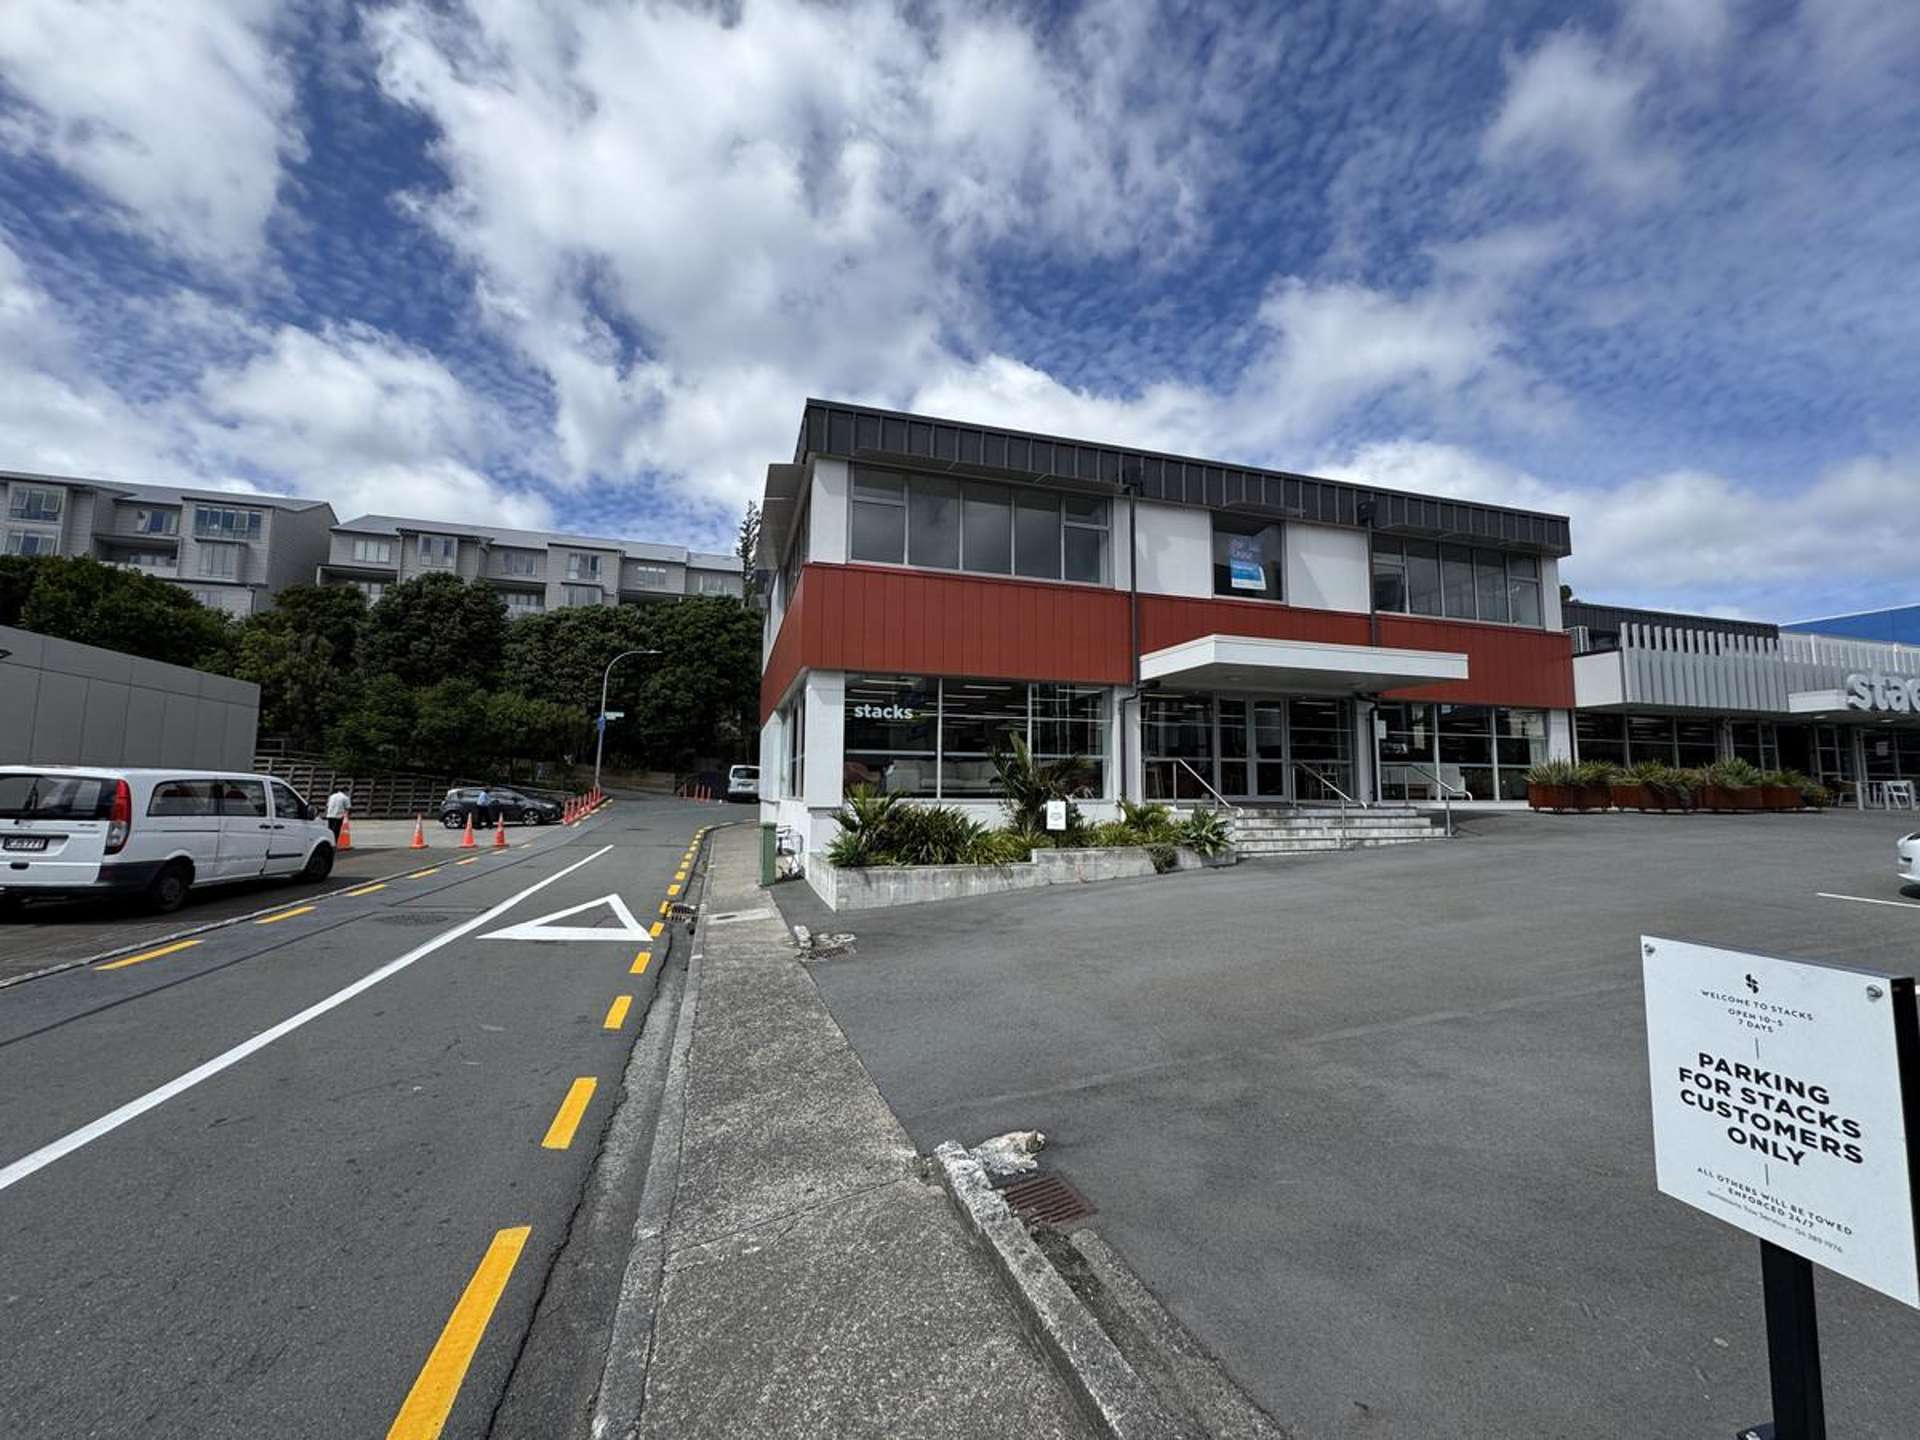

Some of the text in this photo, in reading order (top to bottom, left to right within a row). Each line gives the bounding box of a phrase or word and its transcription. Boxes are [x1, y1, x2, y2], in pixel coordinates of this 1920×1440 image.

[854, 703, 913, 719] stacks
[1700, 989, 1814, 1021] WELCOME TO STACKS
[1728, 1008, 1756, 1020] OPEN
[1747, 1020, 1773, 1033] DAYS
[1699, 1052, 1830, 1105] PARKING
[1679, 1067, 1861, 1139] FOR STACKS
[1680, 1089, 1864, 1164] CUSTOMERS
[1727, 1127, 1806, 1166] ONLY
[1697, 1167, 1714, 1178] ALL
[1717, 1174, 1757, 1196] OTHERS
[1760, 1192, 1786, 1209] WILL
[1790, 1204, 1804, 1215] BE
[1808, 1212, 1853, 1236] TOWED
[1728, 1187, 1785, 1217] ENFORCED
[1788, 1213, 1815, 1229] 24/7
